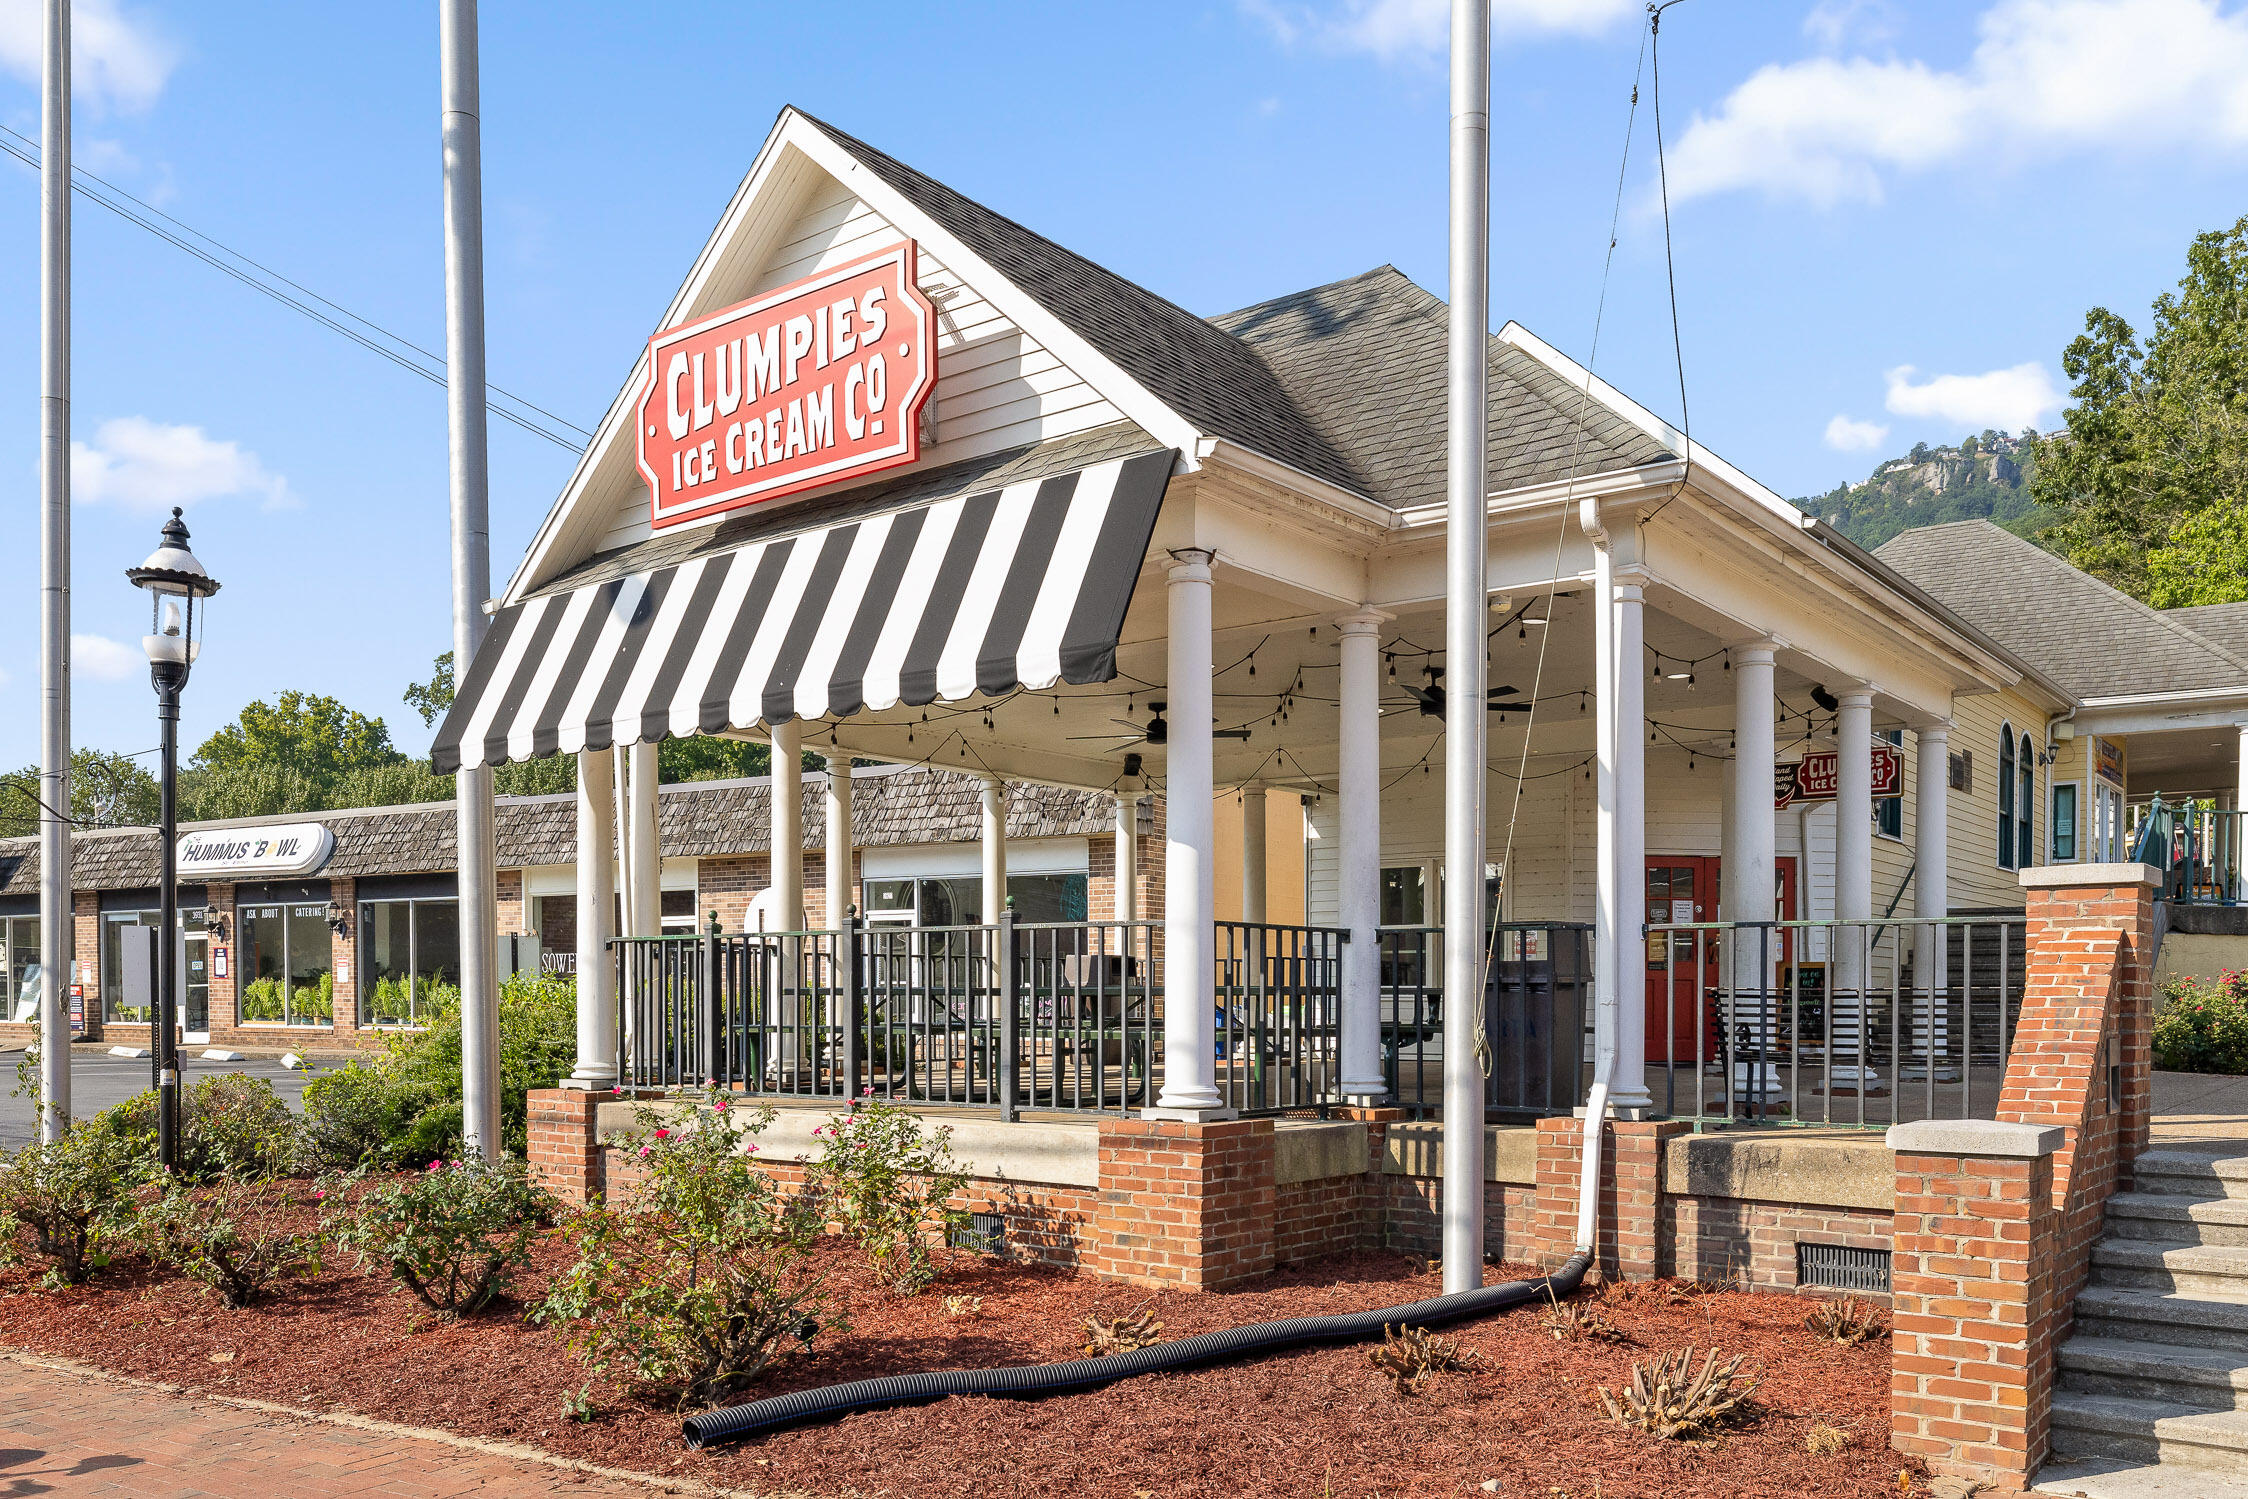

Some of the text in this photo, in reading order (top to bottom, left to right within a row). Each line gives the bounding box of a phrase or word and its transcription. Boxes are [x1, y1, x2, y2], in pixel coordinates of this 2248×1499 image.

[666, 285, 888, 442] CLUMPIES
[671, 438, 719, 492] ICE
[725, 382, 835, 476] CREAM
[1810, 780, 1827, 790] ICE
[182, 841, 250, 861] HUMMUS
[246, 906, 325, 919] ASK ABOUT CATERING!
